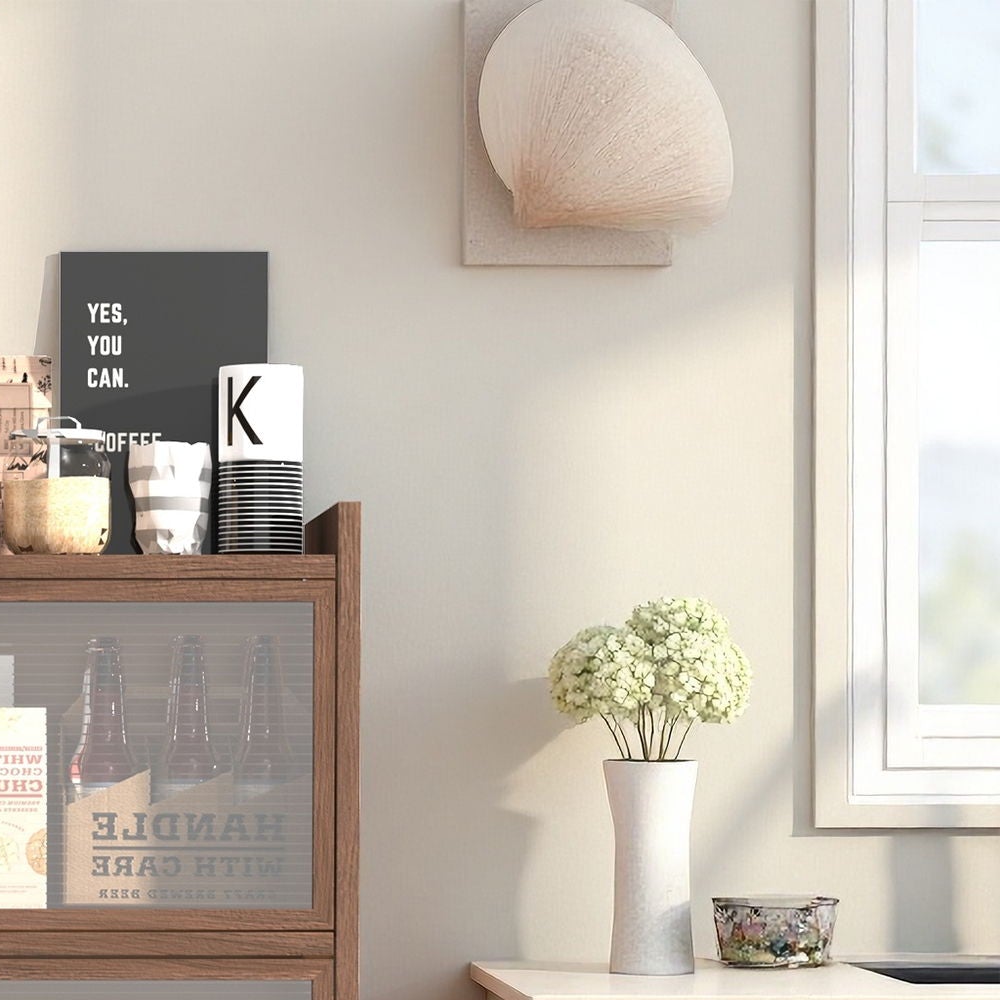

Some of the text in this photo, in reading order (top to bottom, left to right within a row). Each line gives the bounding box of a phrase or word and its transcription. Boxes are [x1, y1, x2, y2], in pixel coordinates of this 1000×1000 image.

[87, 302, 128, 325] YES,
[87, 335, 122, 356] YOU
[87, 367, 129, 389] CAN.
[226, 375, 264, 446] K
